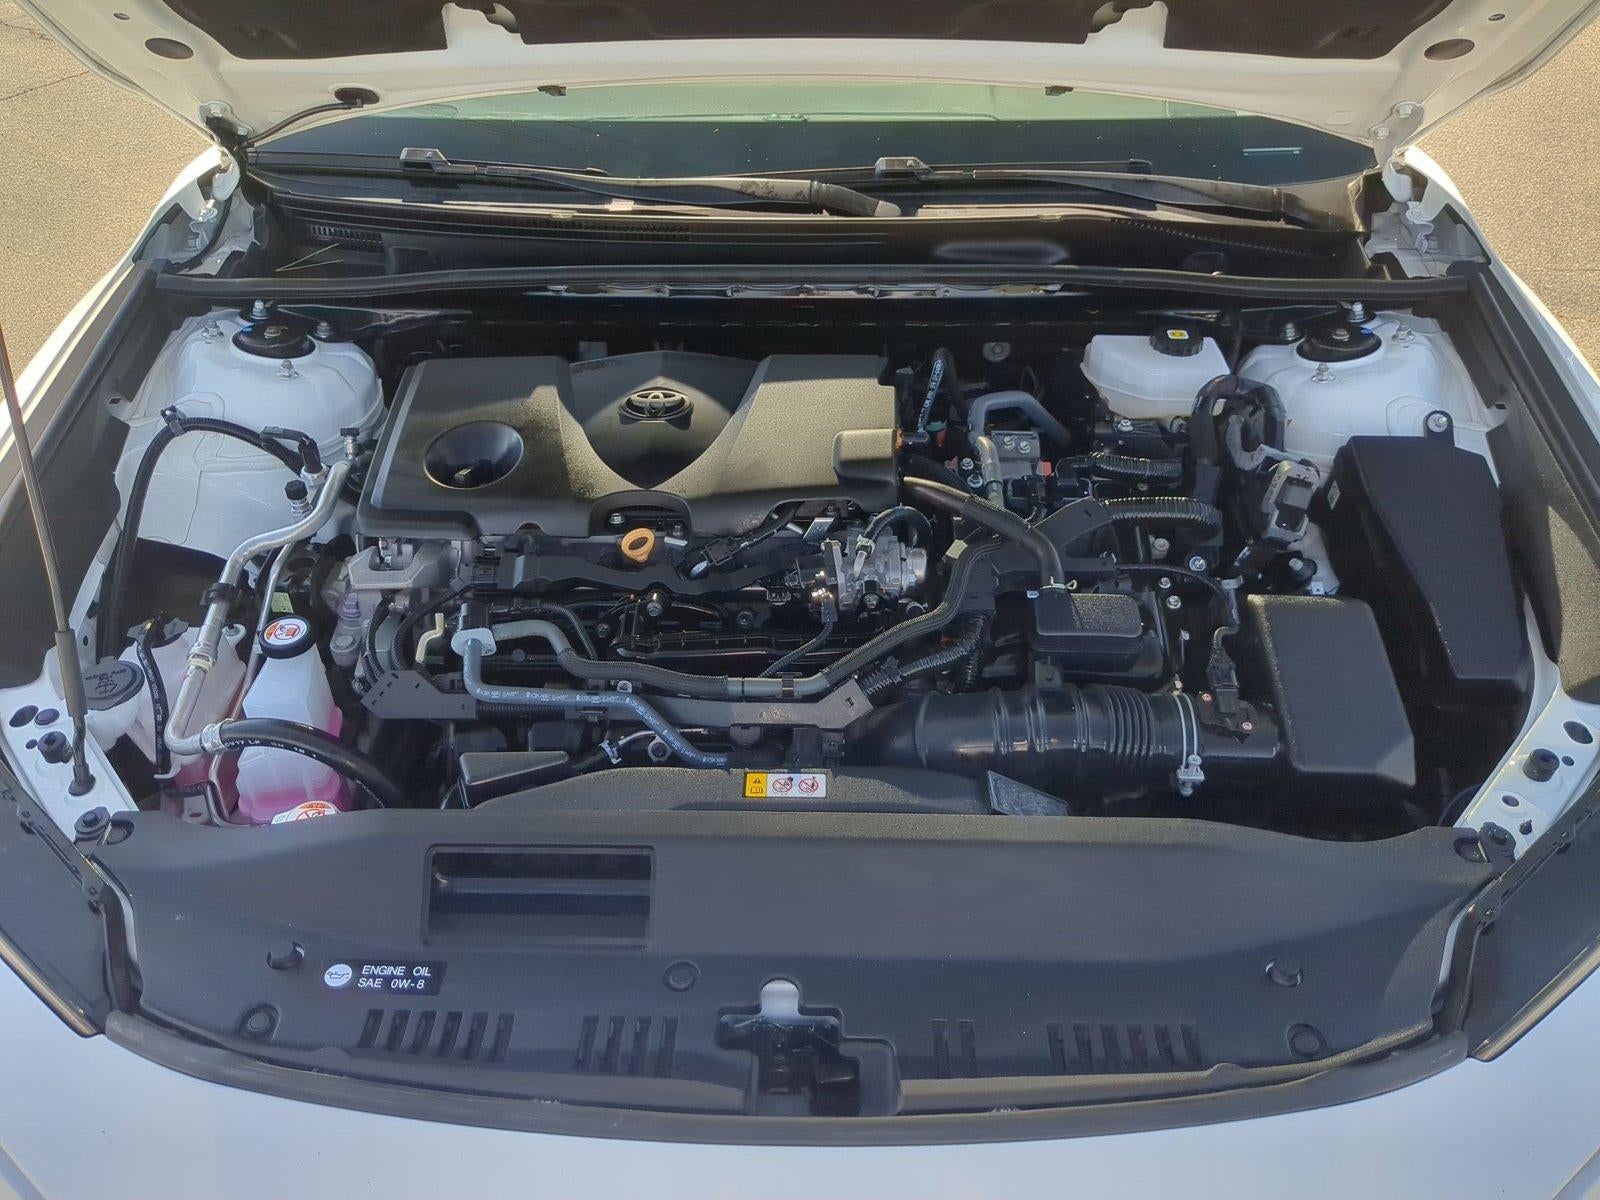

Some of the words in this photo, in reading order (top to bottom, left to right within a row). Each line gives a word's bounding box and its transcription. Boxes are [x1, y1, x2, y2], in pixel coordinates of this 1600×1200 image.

[361, 965, 406, 976] ENGINE
[412, 966, 432, 976] OIL
[357, 977, 384, 988] SAE
[390, 979, 425, 989] 0W-8
